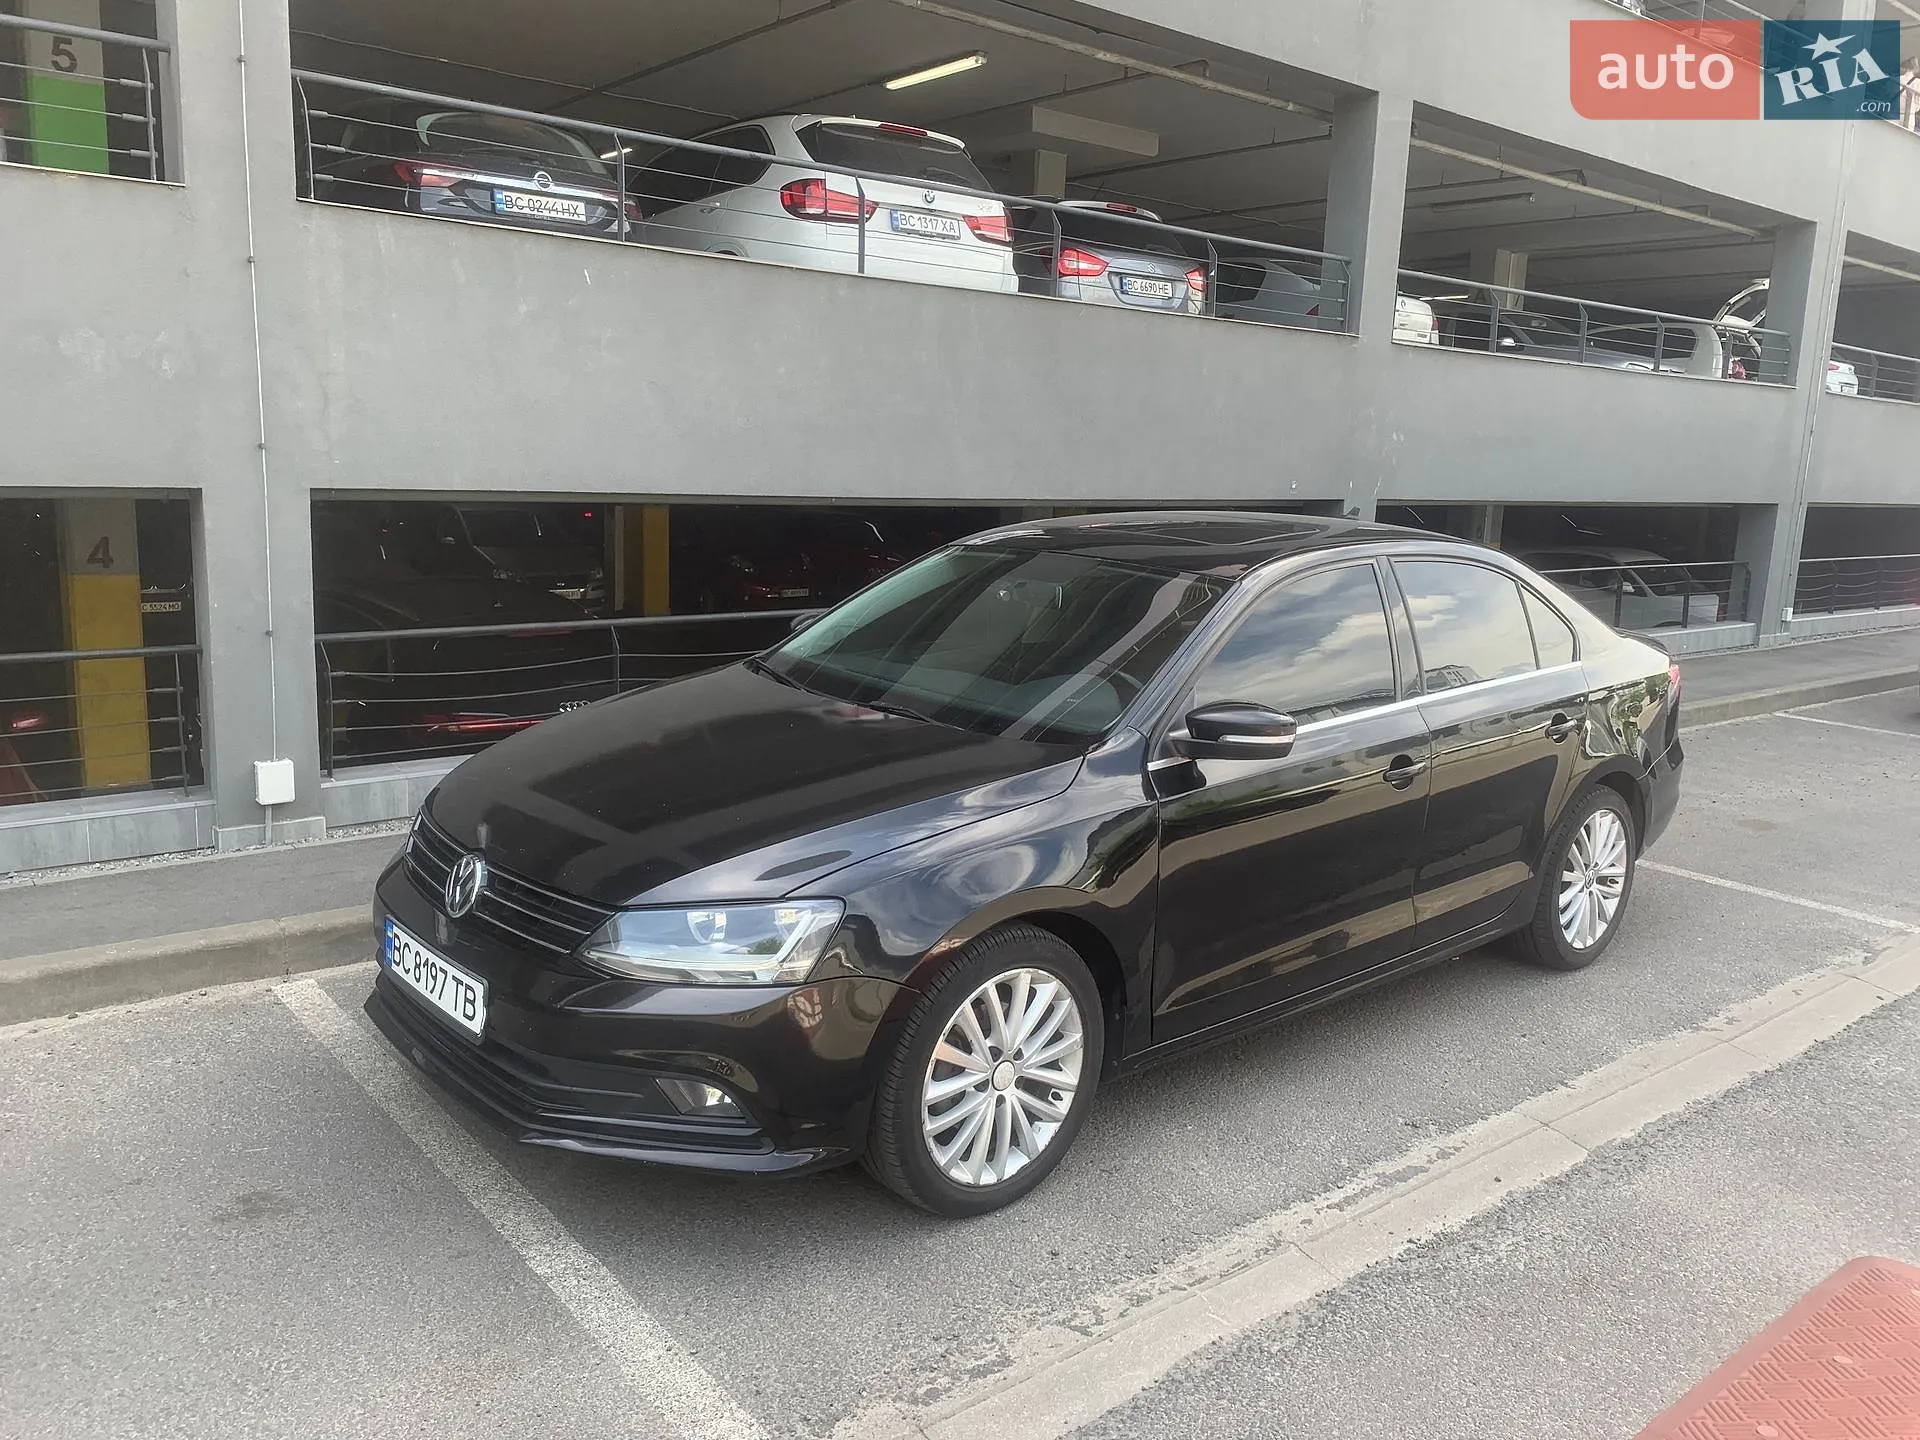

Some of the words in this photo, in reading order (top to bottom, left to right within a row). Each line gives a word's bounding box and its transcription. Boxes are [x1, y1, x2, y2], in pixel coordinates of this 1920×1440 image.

[51, 36, 77, 73] 5
[504, 194, 524, 210] BC
[528, 198, 557, 214] 0244
[561, 203, 580, 218] HX
[899, 213, 916, 227] BC
[917, 217, 939, 231] 1317
[940, 219, 957, 234] XA
[1127, 280, 1139, 291] BC
[1140, 281, 1158, 294] 6690
[1159, 284, 1170, 296] HE
[87, 536, 114, 568] 4
[393, 932, 411, 975] BC
[413, 950, 449, 1001] 8197
[452, 974, 477, 1022] TB
